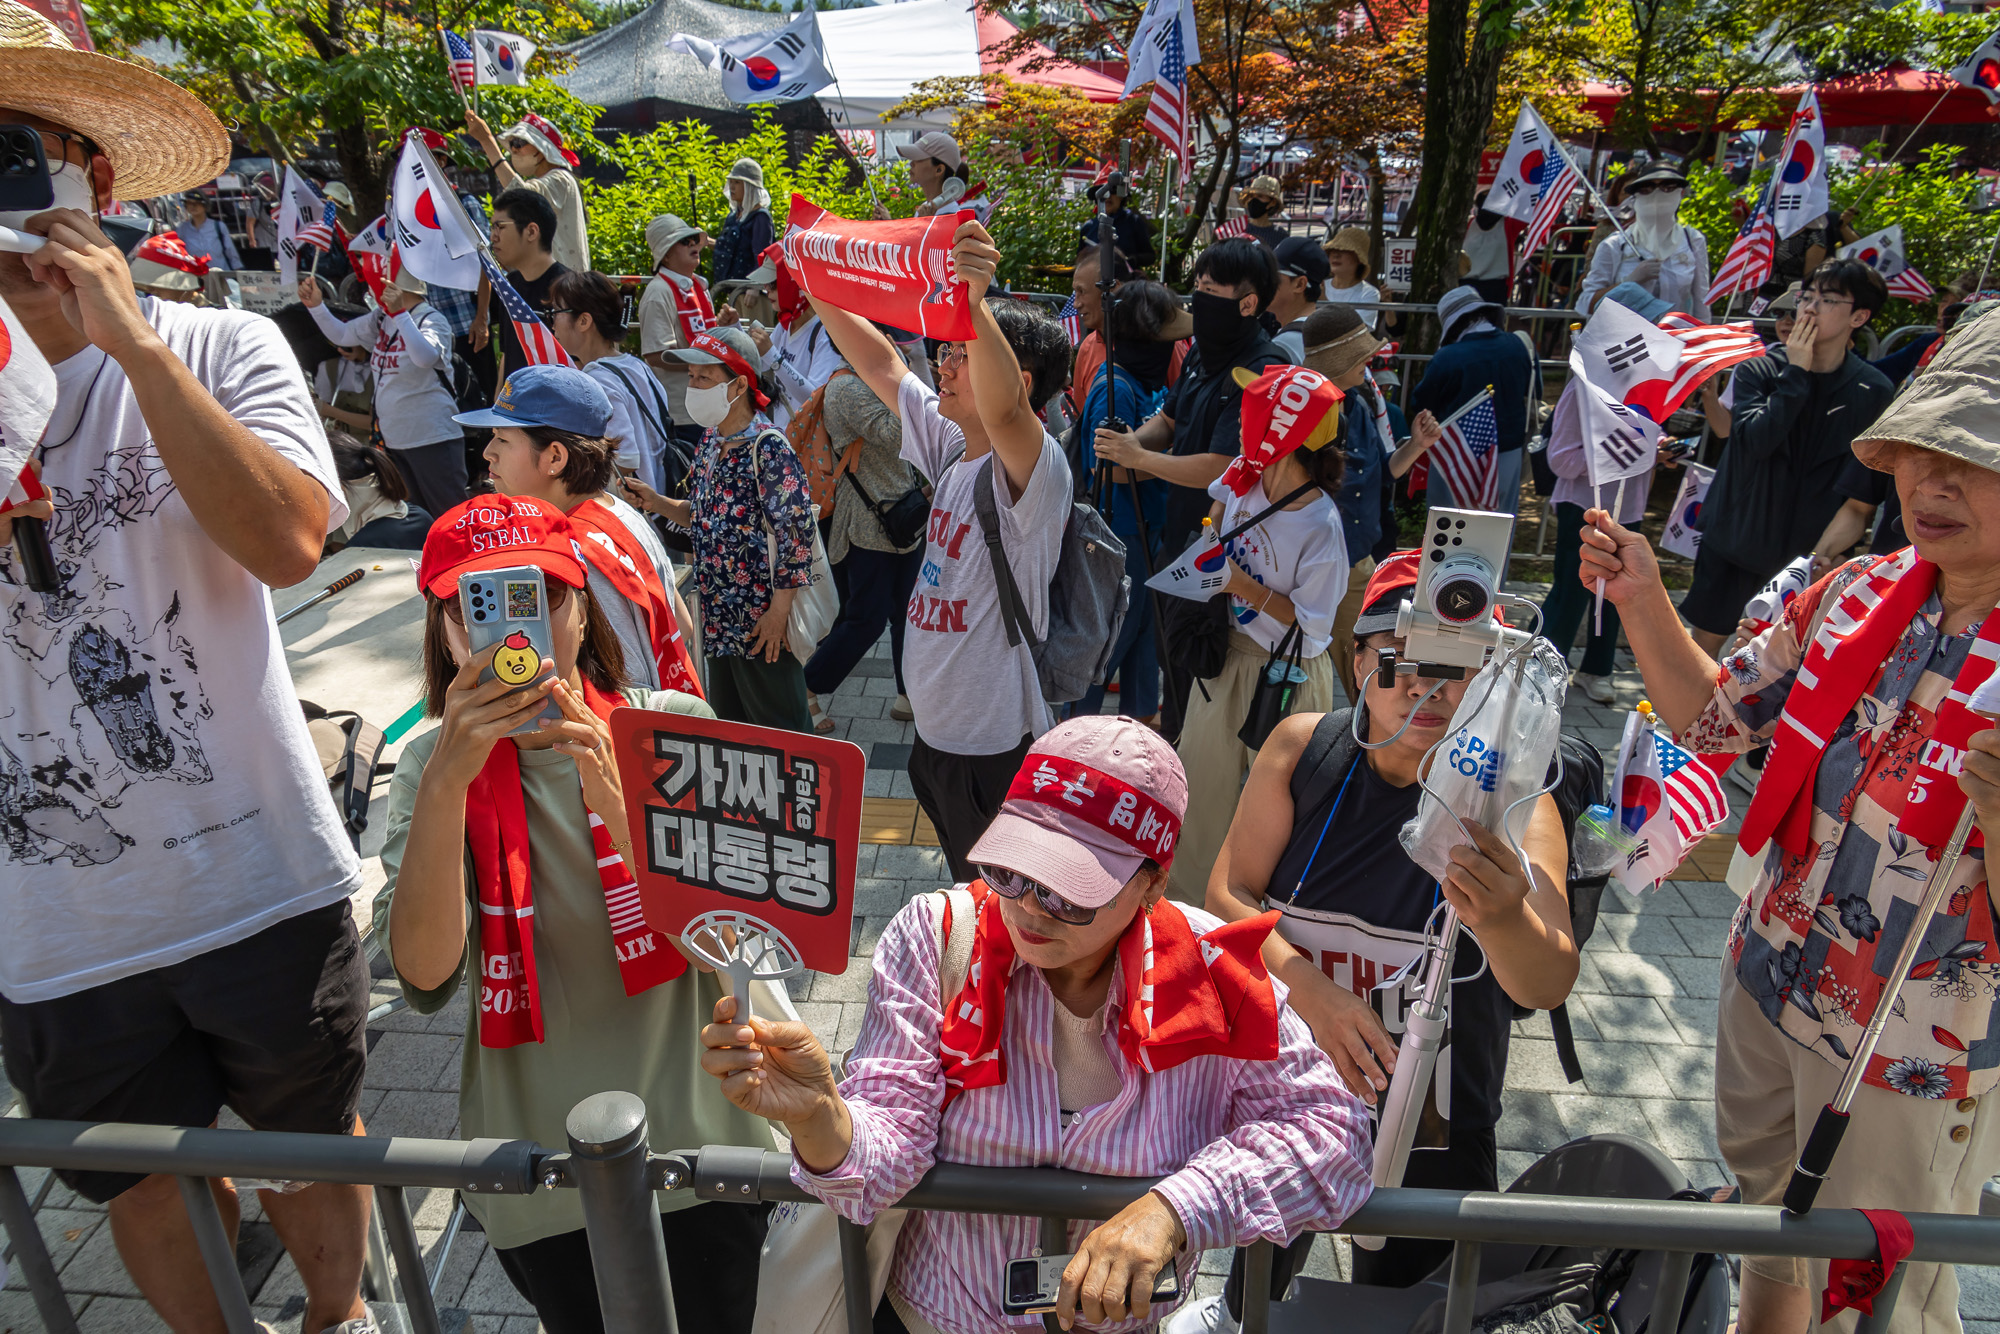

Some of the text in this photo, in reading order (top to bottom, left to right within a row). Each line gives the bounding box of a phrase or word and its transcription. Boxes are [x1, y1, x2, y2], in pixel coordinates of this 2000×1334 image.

[455, 508, 505, 530] STOP
[472, 526, 537, 553] STEAL
[660, 737, 785, 821] 가짜
[794, 761, 815, 831] Fake
[1032, 759, 1174, 854] 구속 이재명
[180, 807, 261, 844] CHANNEL CANDY
[652, 812, 831, 909] 대통령
